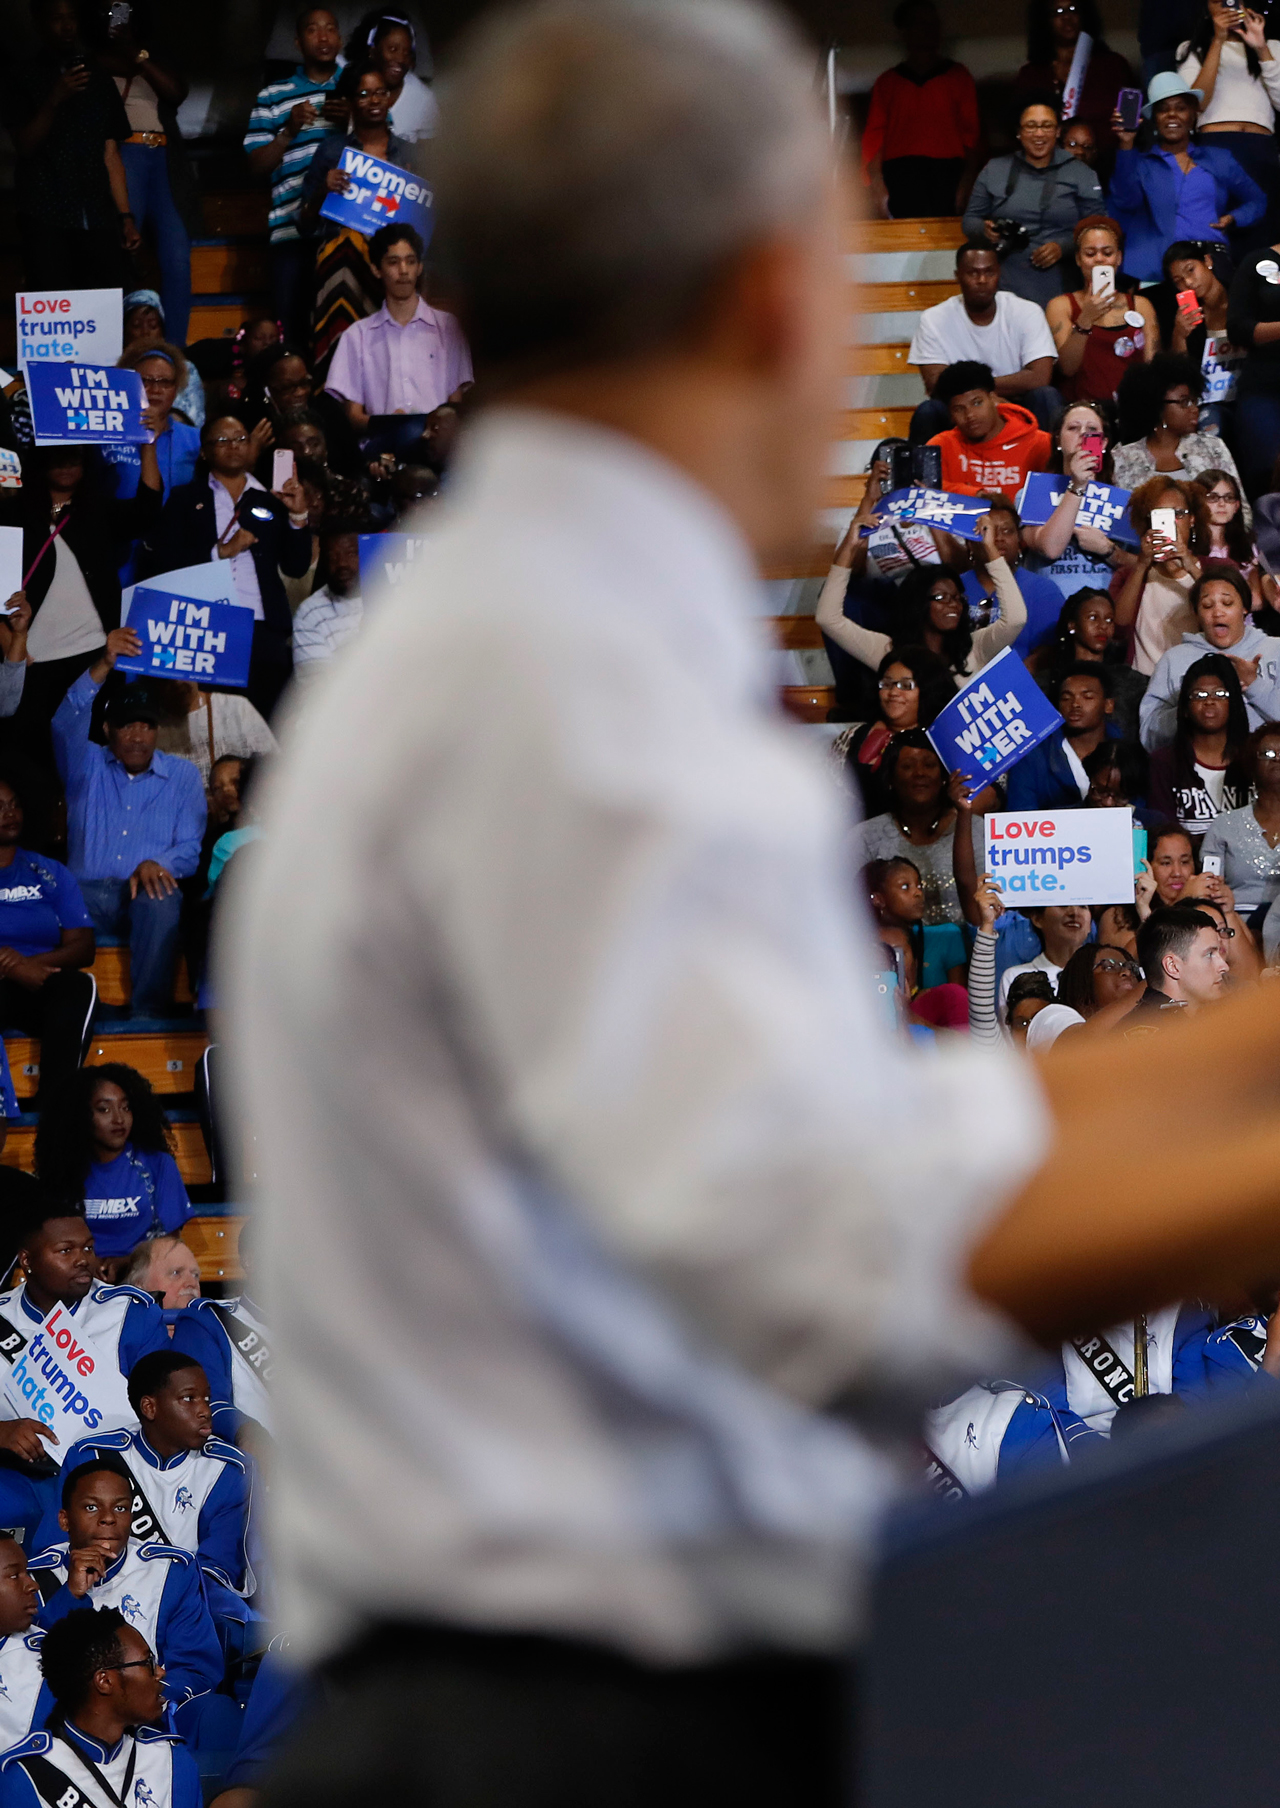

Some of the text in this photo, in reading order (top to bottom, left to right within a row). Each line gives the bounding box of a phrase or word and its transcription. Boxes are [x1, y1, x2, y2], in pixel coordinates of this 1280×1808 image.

[345, 151, 434, 208] Women
[342, 182, 373, 204] or
[20, 297, 71, 314] Love
[19, 318, 96, 339] trumps
[21, 339, 79, 358] hate.
[70, 368, 109, 388] I'M
[55, 388, 130, 410] WITH
[67, 410, 124, 432] HER
[909, 489, 949, 502] I'M
[888, 499, 964, 516] WITH
[1075, 511, 1113, 531] ER
[1050, 565, 1080, 574] FIRST
[169, 600, 210, 628] I'M
[148, 619, 226, 653] WITH
[152, 645, 216, 674] HER
[957, 682, 996, 724] I'M
[954, 691, 1023, 755] WITH
[974, 719, 1033, 771] HER
[990, 818, 1056, 840] Love
[988, 844, 1092, 870] trumps
[991, 869, 1066, 892] hate.
[26, 1066, 34, 1075] 4
[99, 1196, 142, 1214] MBX
[45, 1308, 95, 1377] Love
[1074, 1335, 1135, 1403] RONC
[28, 1333, 103, 1429] trumps
